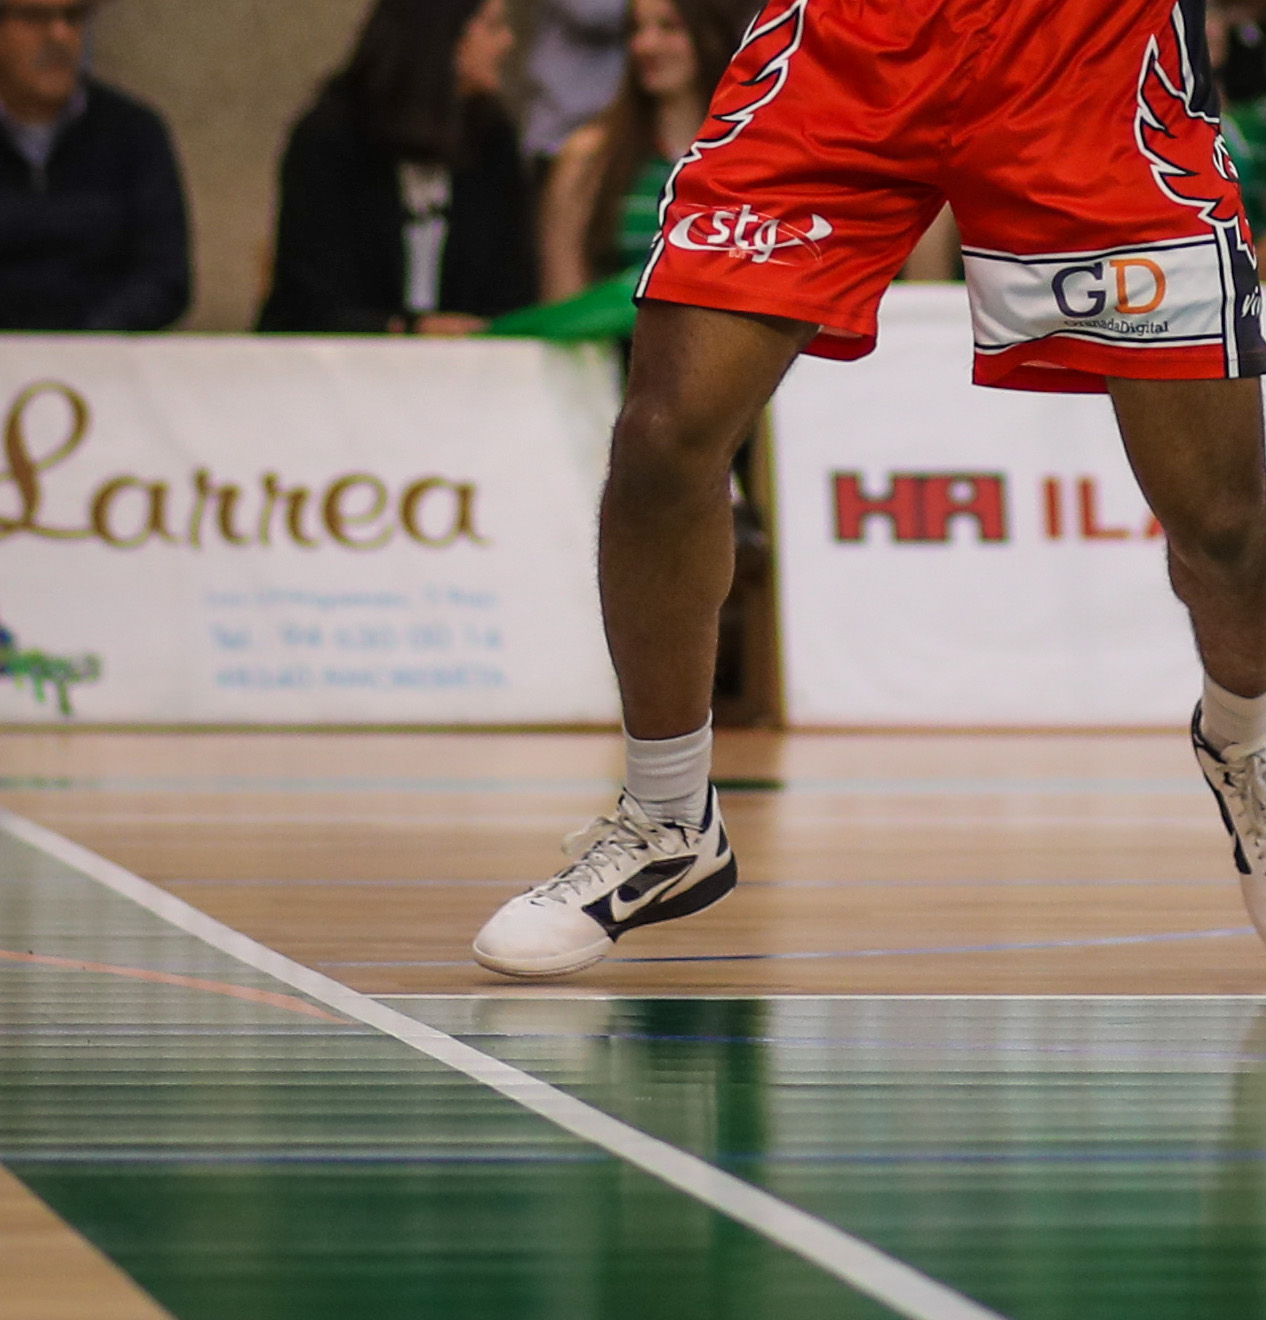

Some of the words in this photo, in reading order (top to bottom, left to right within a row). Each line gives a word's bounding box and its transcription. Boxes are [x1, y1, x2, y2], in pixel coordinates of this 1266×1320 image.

[707, 204, 780, 263] stg
[1051, 257, 1166, 318] GD
[0, 378, 493, 550] Larrea
